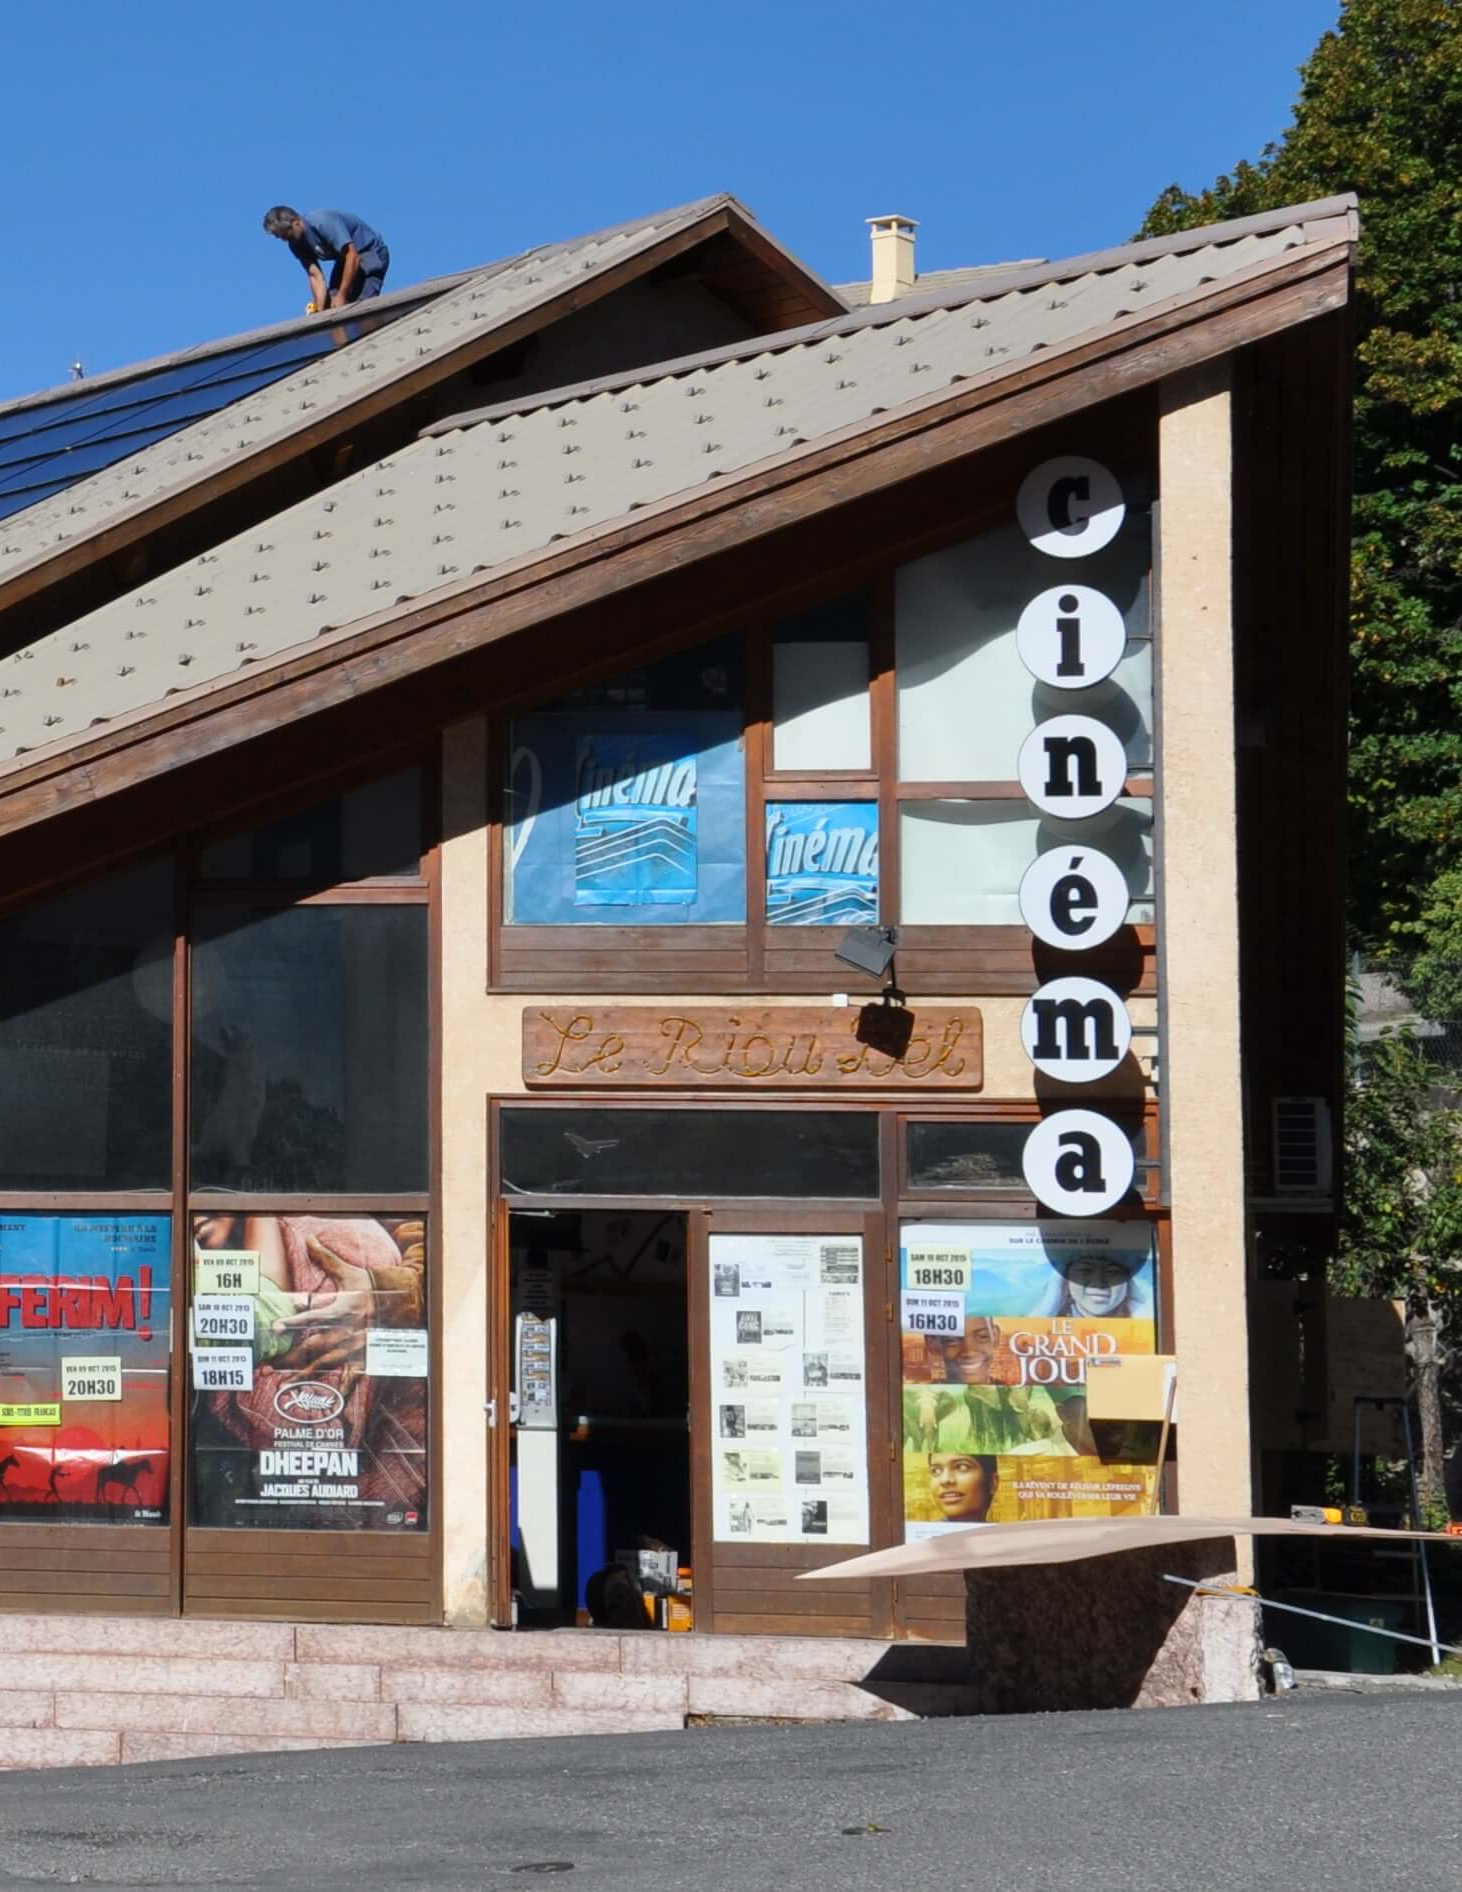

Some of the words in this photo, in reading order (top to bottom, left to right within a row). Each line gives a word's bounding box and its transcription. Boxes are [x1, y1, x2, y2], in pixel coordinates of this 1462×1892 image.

[537, 1012, 625, 1076] Le
[216, 1272, 242, 1288] 16H
[914, 1269, 964, 1285] 18H30
[200, 1318, 248, 1334] 20H30
[908, 1313, 958, 1331] 16H30
[1051, 1319, 1074, 1334] LE
[1009, 1331, 1117, 1357] GRAND
[202, 1370, 244, 1385] 18H15
[1017, 1356, 1086, 1388] JOU
[68, 1379, 116, 1395] 20H30
[274, 1428, 313, 1439] PALME
[315, 1428, 345, 1439] D'OR
[259, 1450, 359, 1476] DHEEPAN
[260, 1484, 310, 1498] JACQUES
[311, 1485, 359, 1498] AUDIARD
